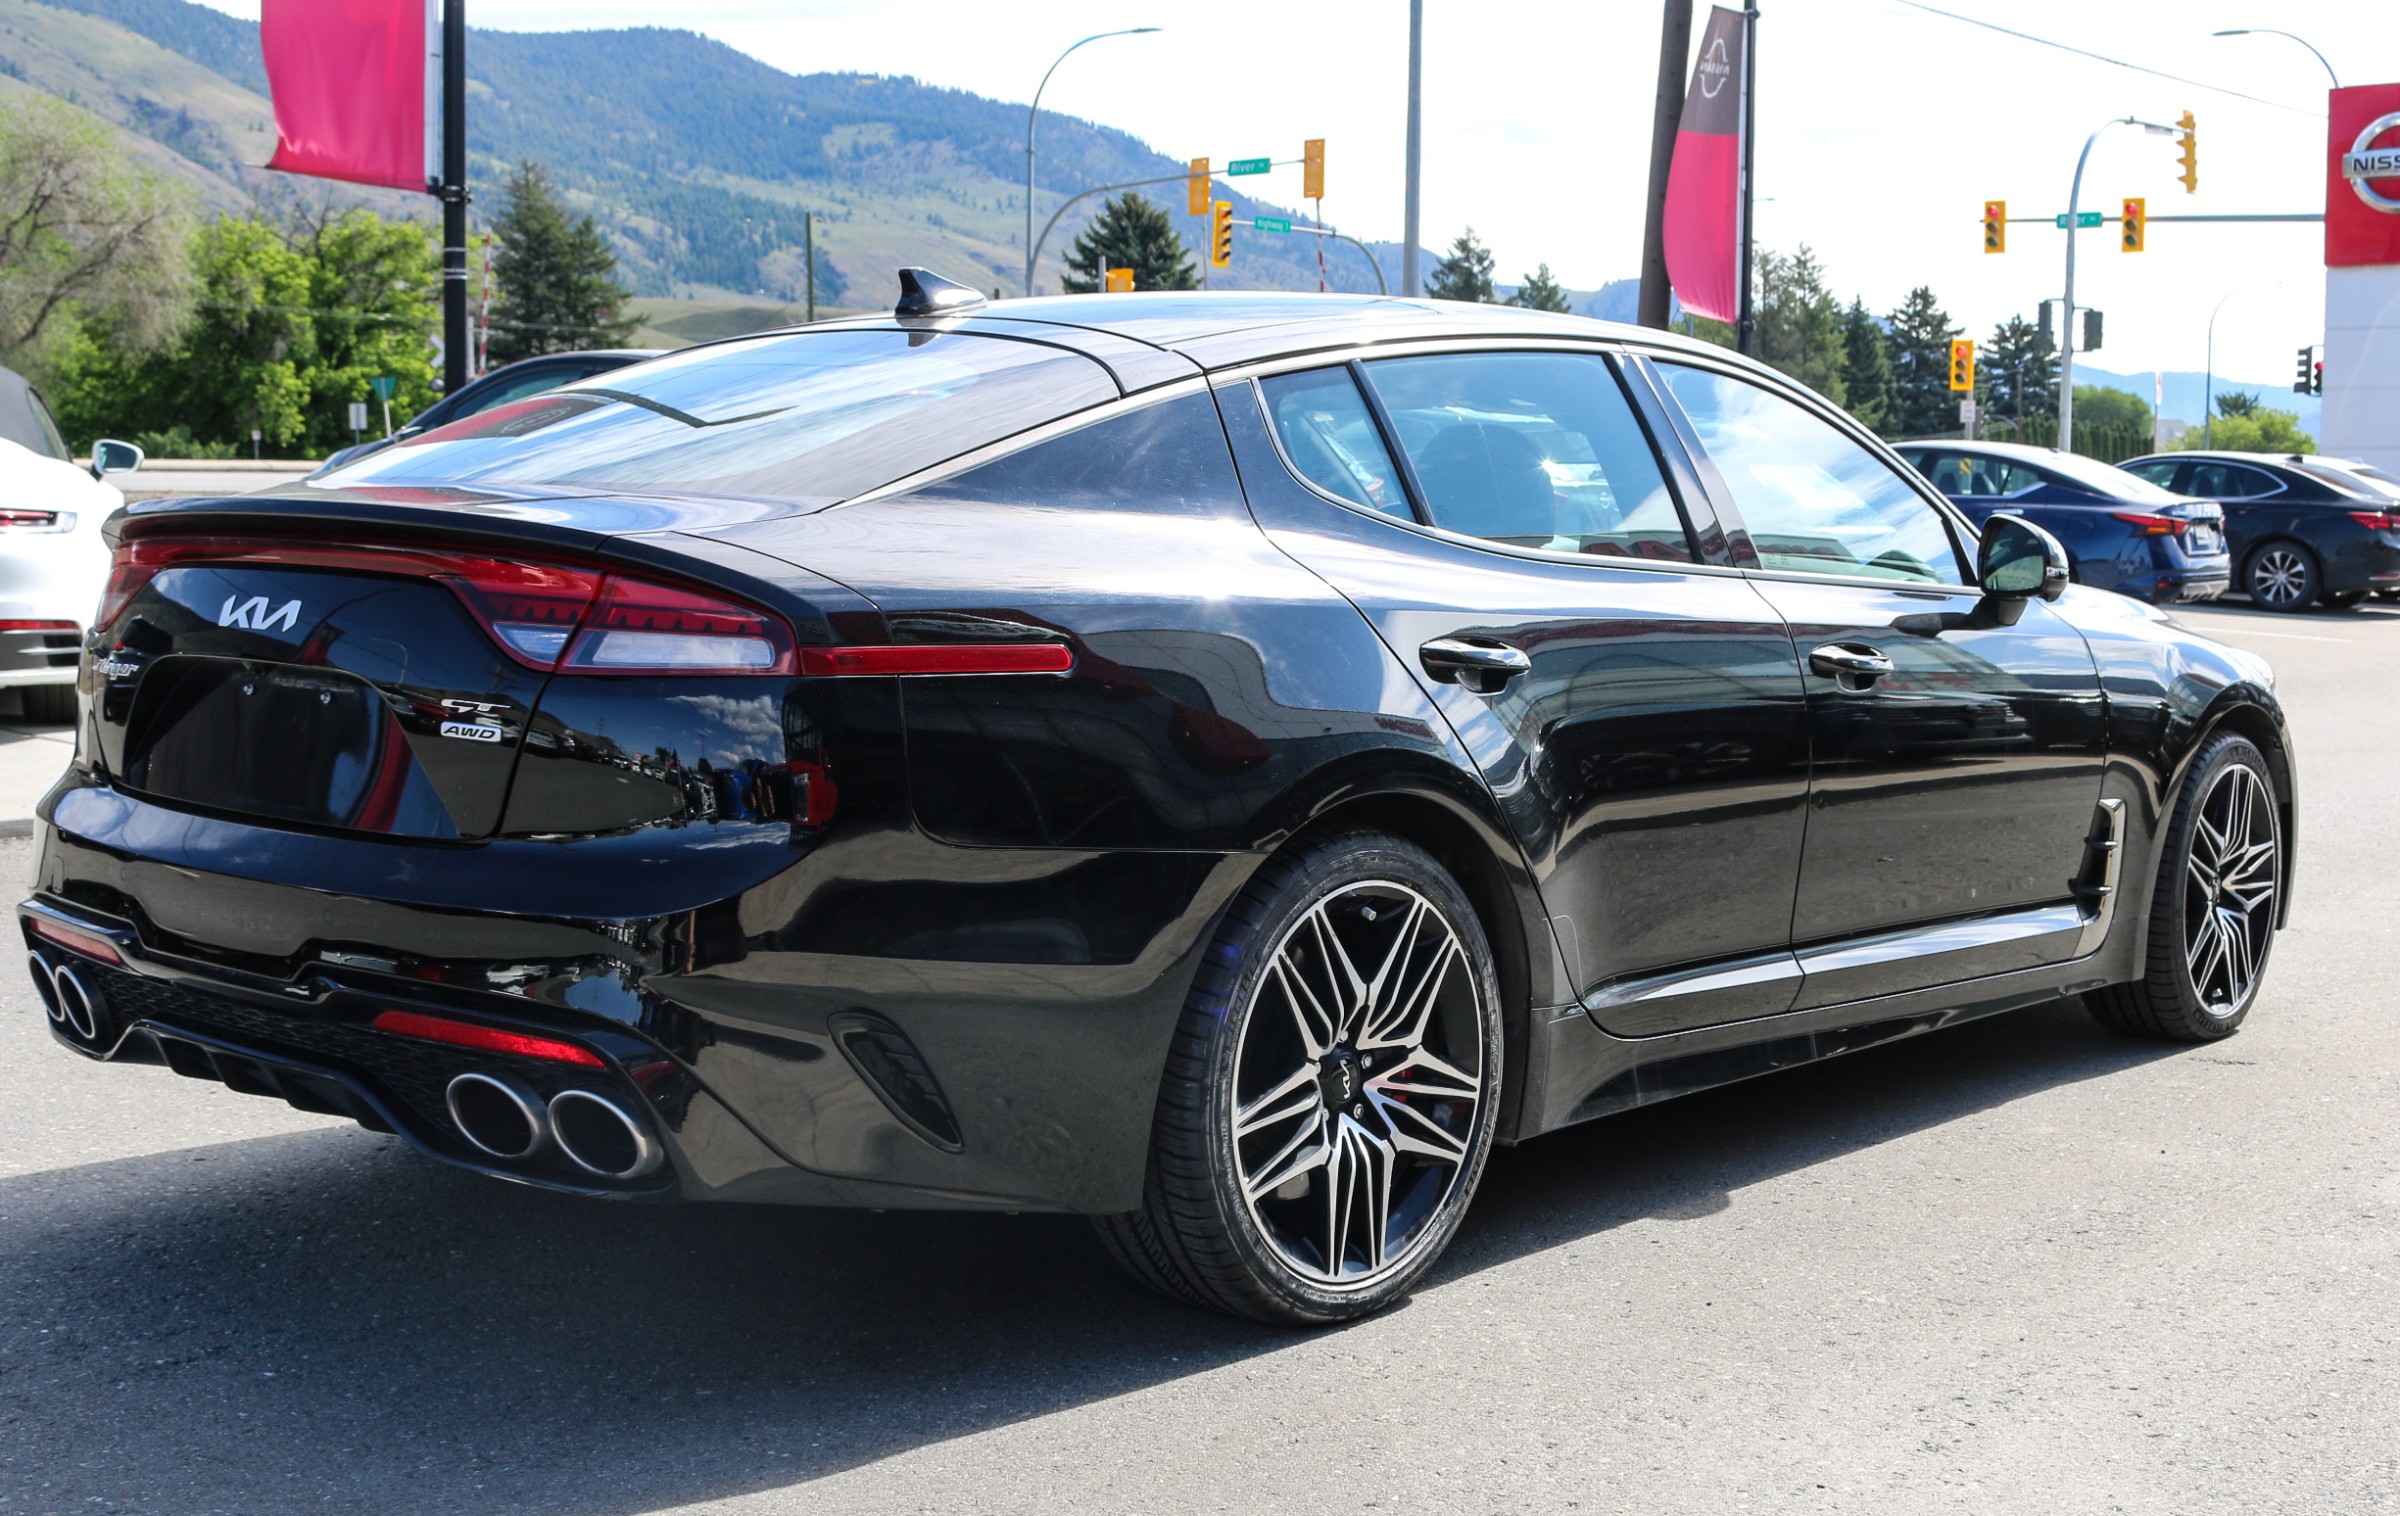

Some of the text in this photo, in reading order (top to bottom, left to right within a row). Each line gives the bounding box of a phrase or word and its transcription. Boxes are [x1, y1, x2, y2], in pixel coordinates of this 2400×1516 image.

[1231, 161, 1255, 173] River
[217, 594, 302, 632] KIA
[443, 725, 496, 739] AWD
